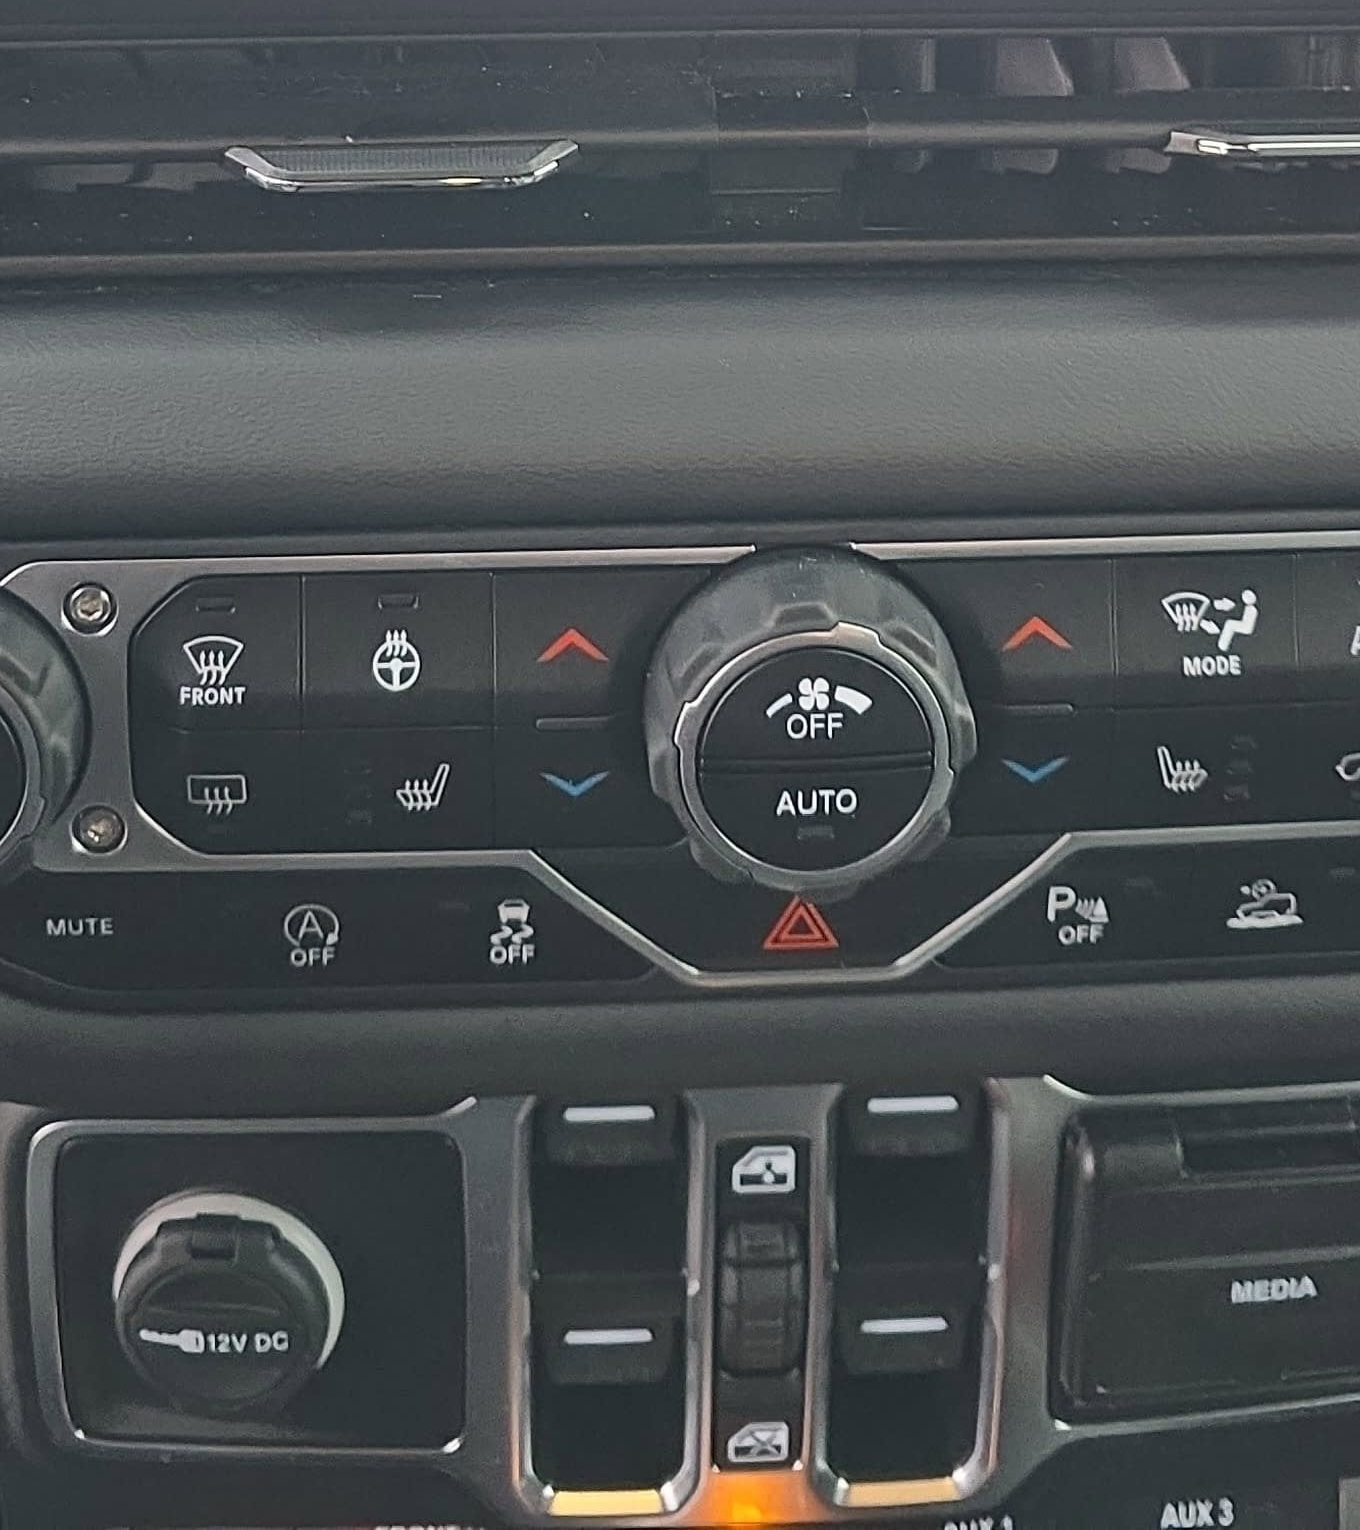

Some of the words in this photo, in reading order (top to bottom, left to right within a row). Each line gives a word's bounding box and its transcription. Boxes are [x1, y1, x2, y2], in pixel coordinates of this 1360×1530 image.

[1183, 655, 1242, 676] MODE
[180, 686, 245, 706] FRONT
[786, 713, 843, 740] OFF
[776, 789, 858, 817] AUTO
[46, 917, 114, 936] MUTE
[1058, 925, 1104, 945] OFF
[290, 947, 335, 967] OFF
[490, 944, 535, 965] OFF
[1231, 1276, 1318, 1303] MEDIA
[207, 1333, 248, 1353] 12V
[255, 1331, 289, 1353] DC
[1161, 1502, 1213, 1528] AUX
[1217, 1497, 1235, 1527] 3
